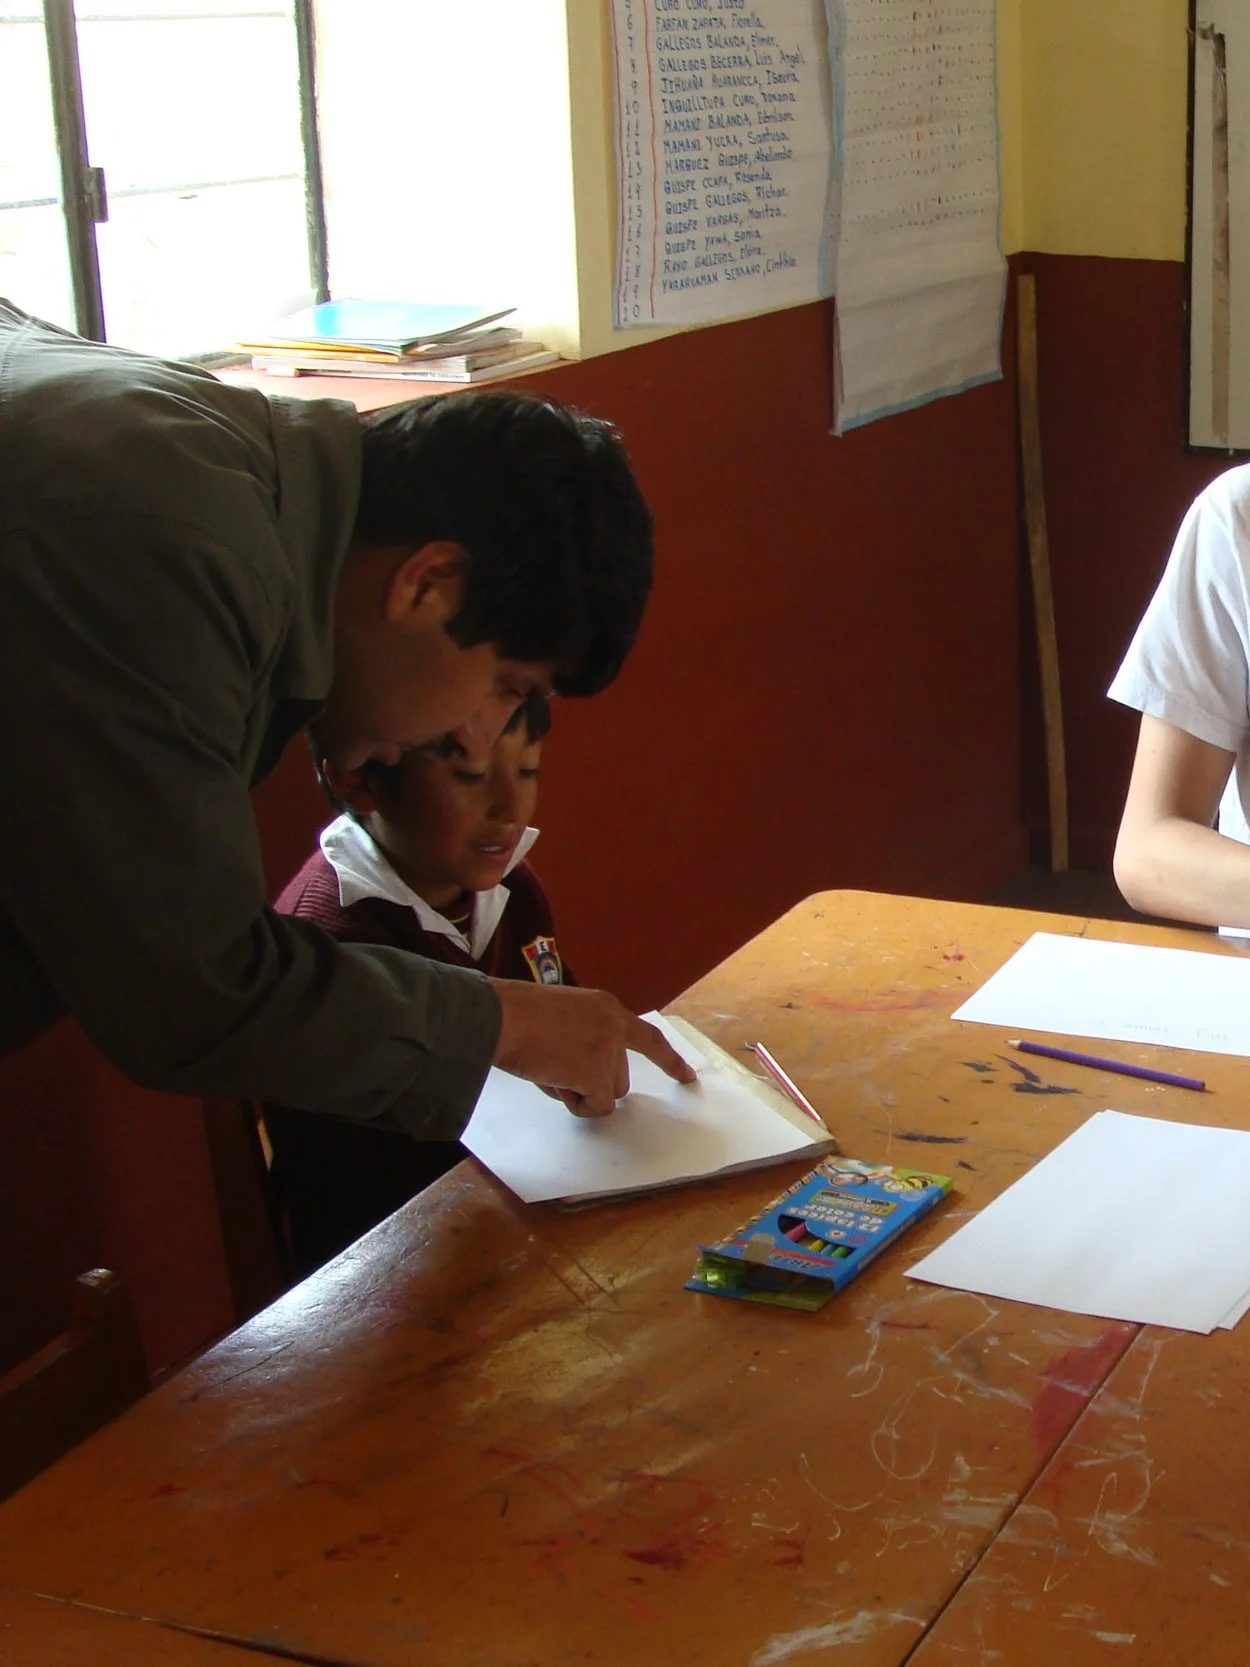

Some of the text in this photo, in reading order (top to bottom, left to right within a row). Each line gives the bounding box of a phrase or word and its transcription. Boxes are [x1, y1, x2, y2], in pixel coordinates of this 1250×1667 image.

[627, 13, 633, 30] 6
[656, 16, 689, 32] FARFAN
[656, 35, 702, 51] GALLEGOS
[658, 57, 707, 73] GALLEGOS
[625, 100, 639, 116] 10
[626, 119, 639, 137] 11
[663, 117, 701, 134] MAMANI
[663, 138, 702, 155] MAMANI
[627, 160, 642, 178] 13
